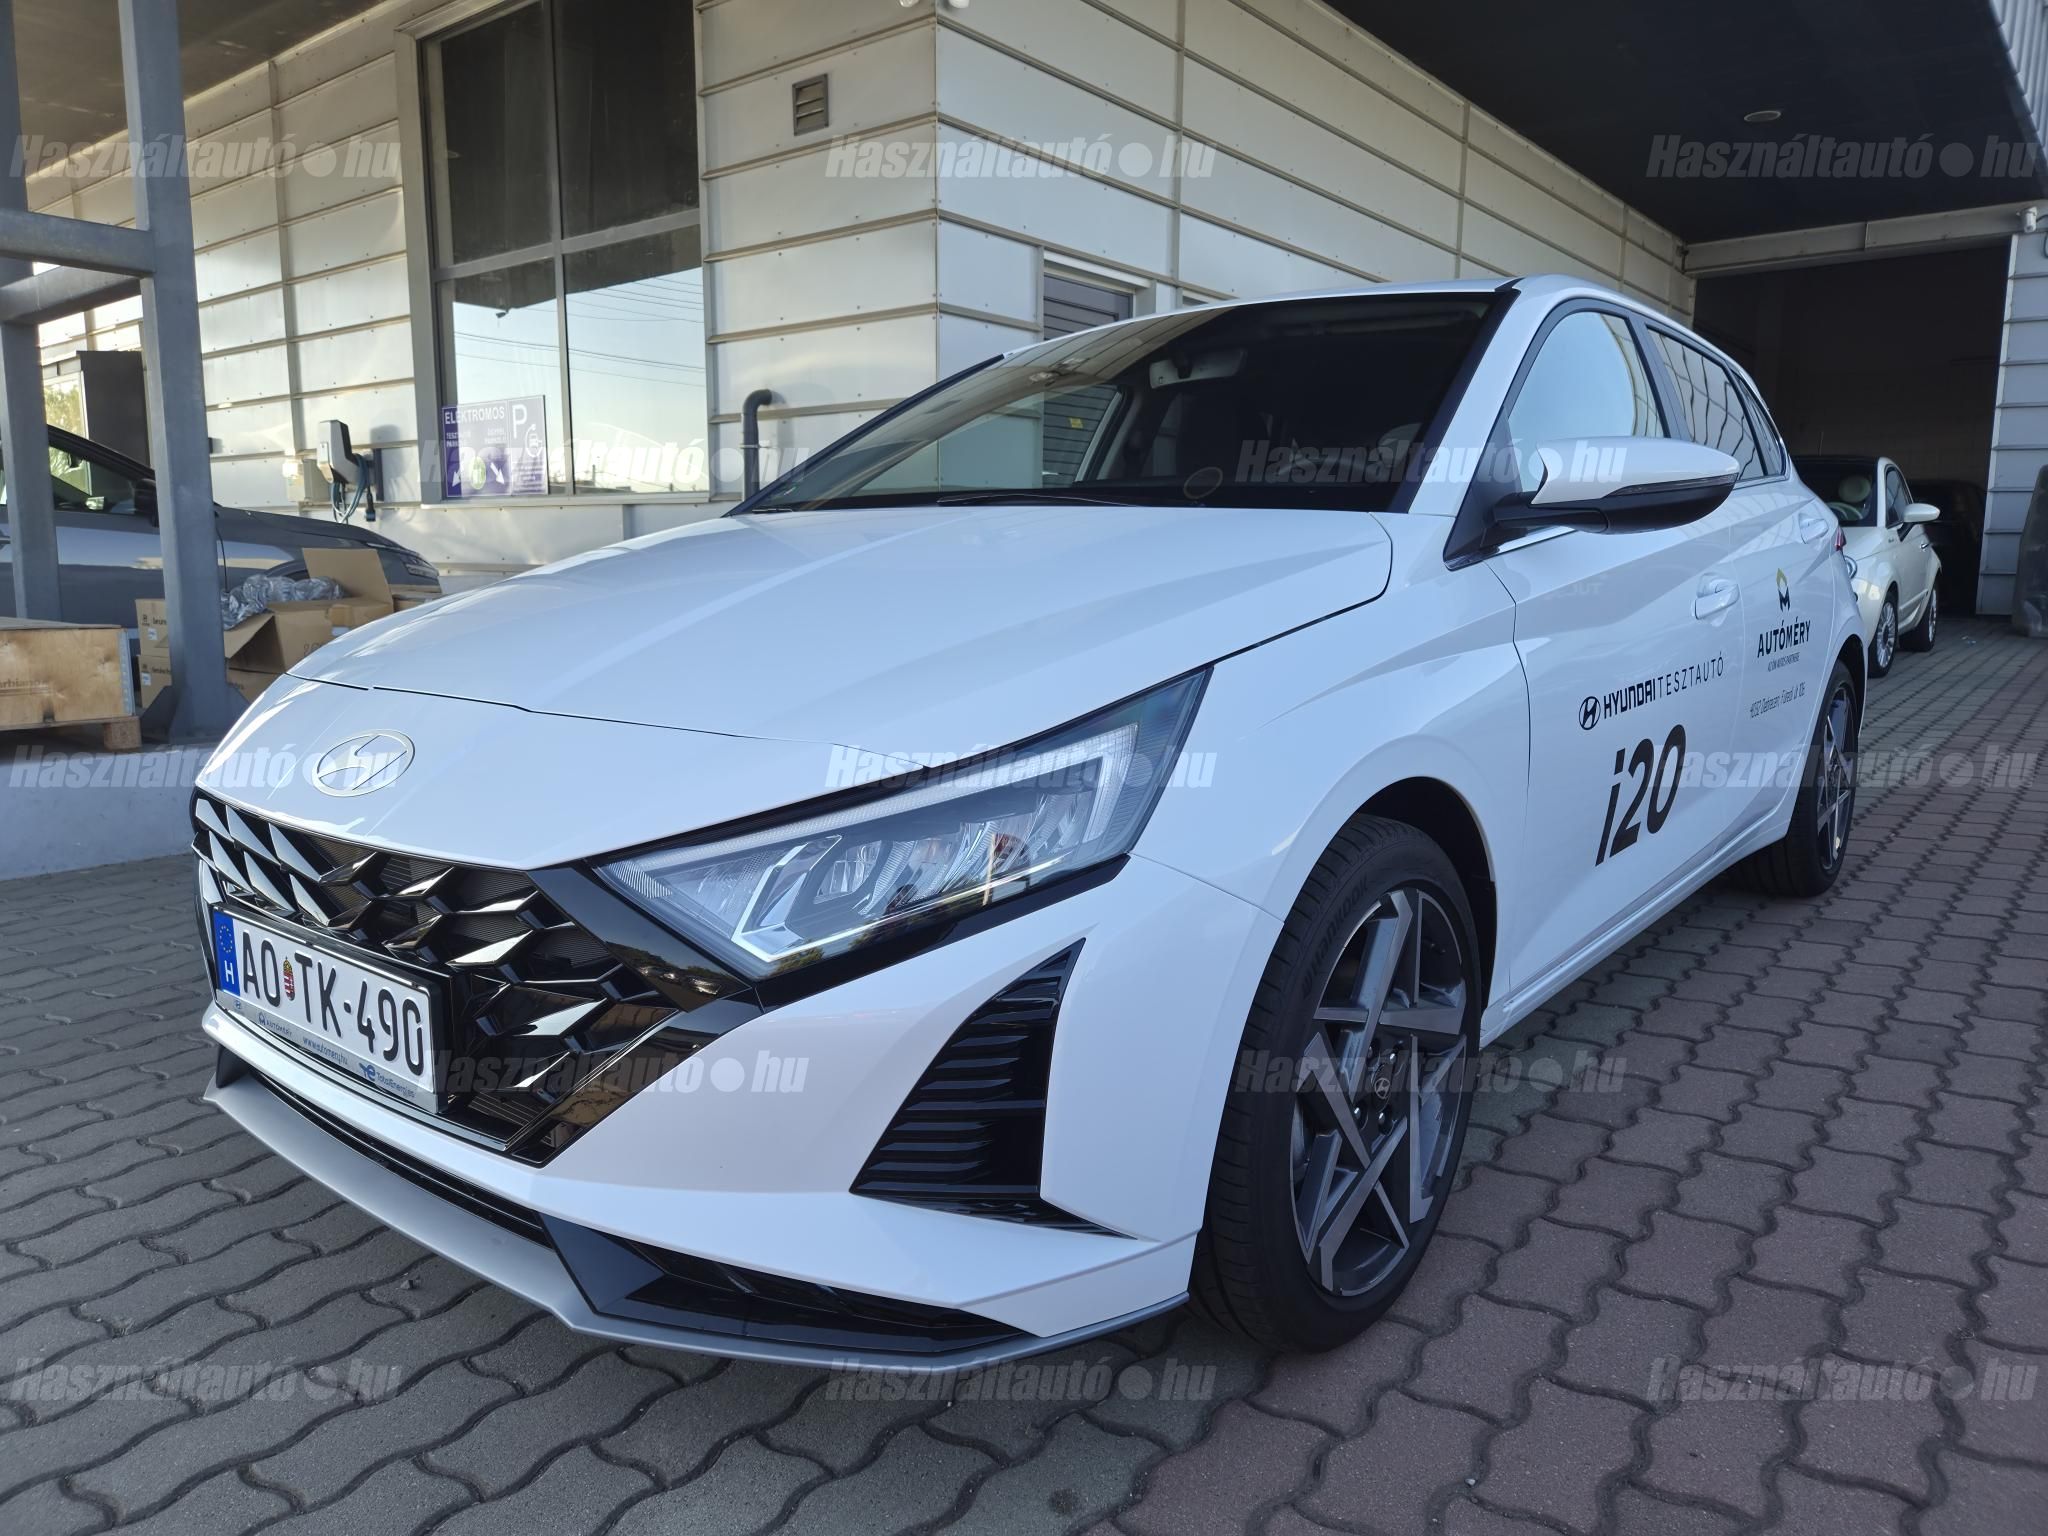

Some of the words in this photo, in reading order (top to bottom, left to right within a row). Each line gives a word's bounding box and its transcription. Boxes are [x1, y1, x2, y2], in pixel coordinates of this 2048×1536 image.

[445, 407, 505, 425] ELEKTROMOS
[512, 403, 527, 439] P
[1757, 616, 1810, 658] AUTÓMÉRY
[1603, 678, 1656, 719] HYUNDAI
[1657, 651, 1724, 698] TESZTAUTÓ
[1595, 724, 1686, 867] i20
[224, 961, 235, 985] H
